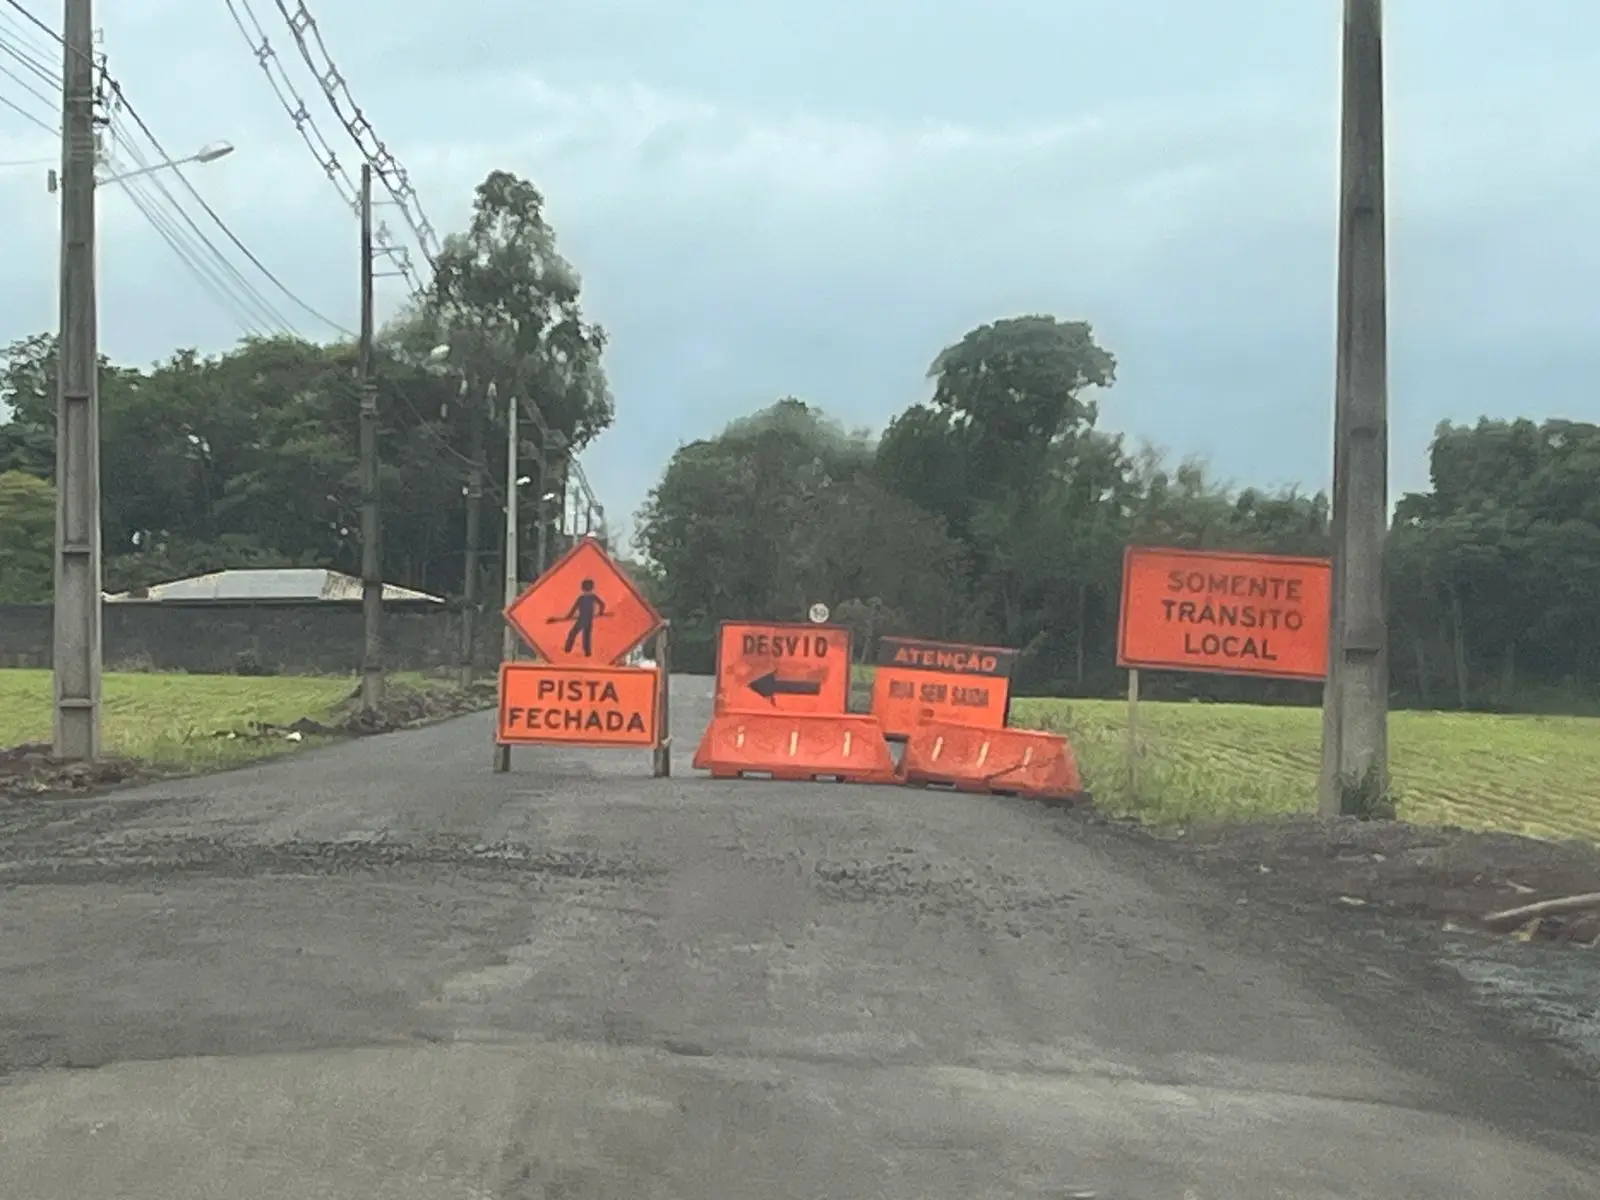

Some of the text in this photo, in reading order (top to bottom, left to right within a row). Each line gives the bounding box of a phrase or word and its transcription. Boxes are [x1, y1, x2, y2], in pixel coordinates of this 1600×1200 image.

[1167, 571, 1302, 601] SOMENTE
[742, 634, 828, 659] DESVIO
[1184, 633, 1277, 660] LOCAL
[895, 647, 997, 672] ATENÇÃO
[537, 679, 619, 703] PISTA
[508, 708, 646, 733] FECHADA
